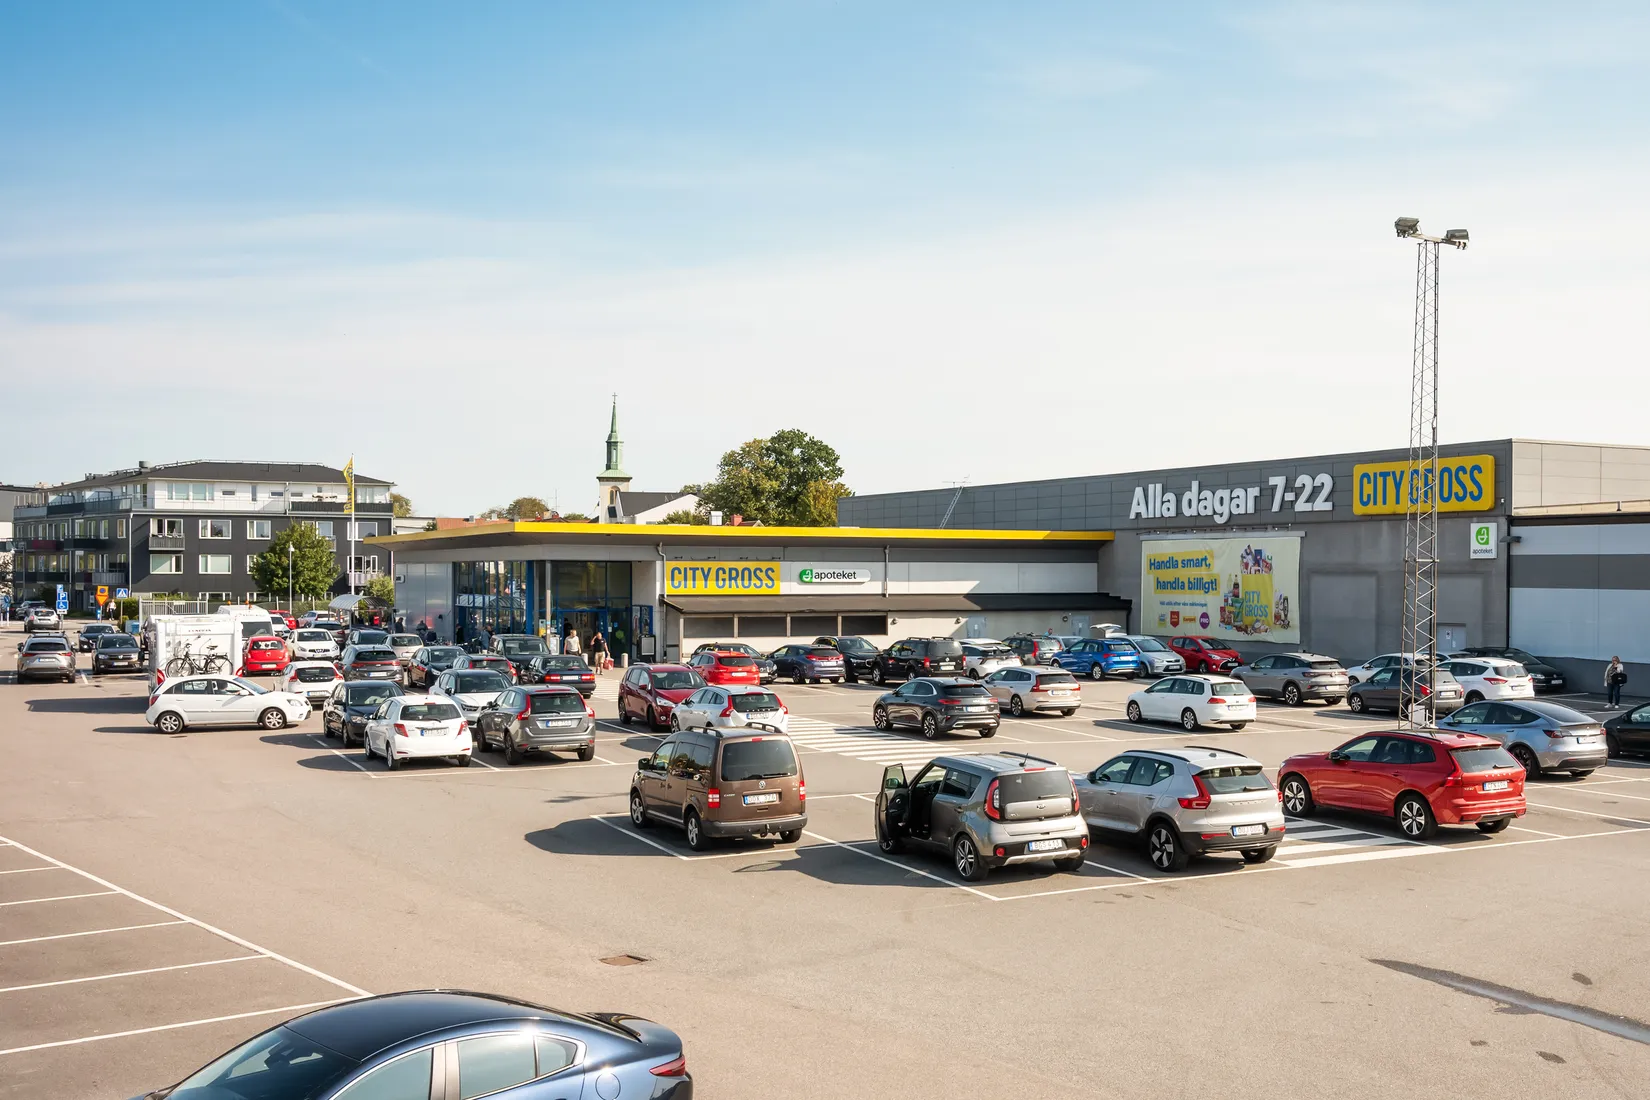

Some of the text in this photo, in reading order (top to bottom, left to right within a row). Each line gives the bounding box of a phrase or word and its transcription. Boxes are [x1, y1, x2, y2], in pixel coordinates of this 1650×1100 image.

[1359, 470, 1405, 507] CITY
[1129, 473, 1334, 524] Alla dagar 7-22
[1149, 555, 1211, 570] Handla smart,
[670, 566, 775, 589] CITY GROSS
[814, 570, 857, 582] apoteket
[1156, 577, 1218, 594] handla billigt!
[1244, 591, 1260, 604] CITY
[1244, 604, 1268, 618] GROSS
